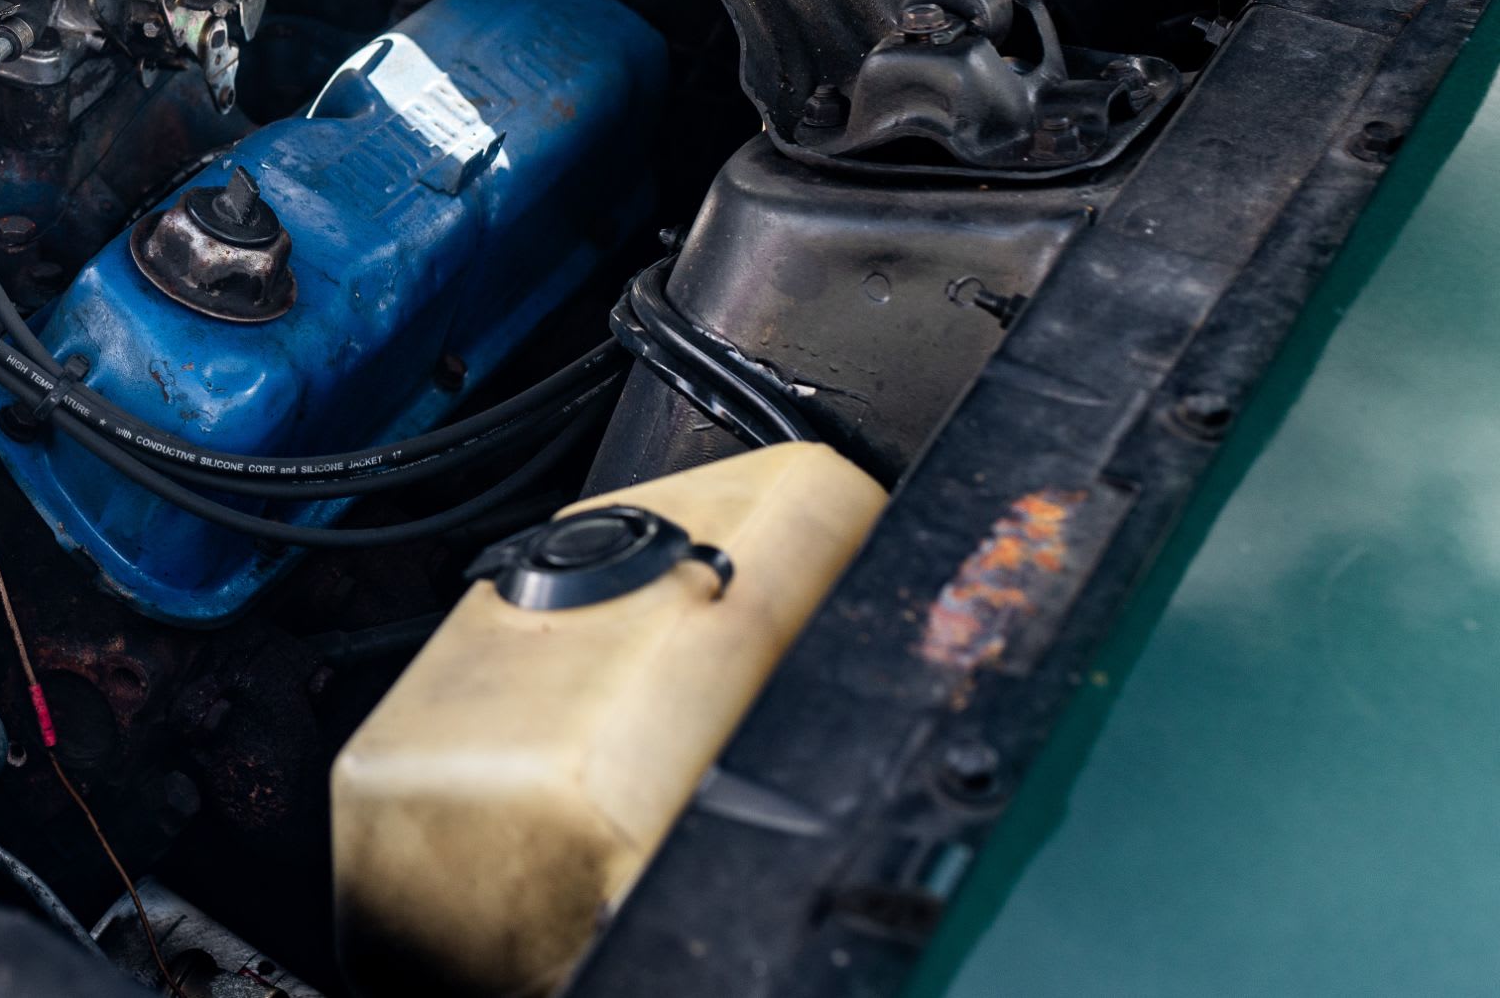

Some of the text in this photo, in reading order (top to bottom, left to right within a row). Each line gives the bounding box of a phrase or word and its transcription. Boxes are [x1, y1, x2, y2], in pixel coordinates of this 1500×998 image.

[6, 354, 29, 374] HIGH
[30, 371, 92, 417] TEMPATURE
[115, 426, 132, 440] with
[135, 435, 196, 463] CONDUCTIVE
[200, 456, 244, 472] SILICONE
[280, 466, 297, 474] and
[301, 462, 344, 474] SILICONE
[348, 455, 383, 469] JACKET
